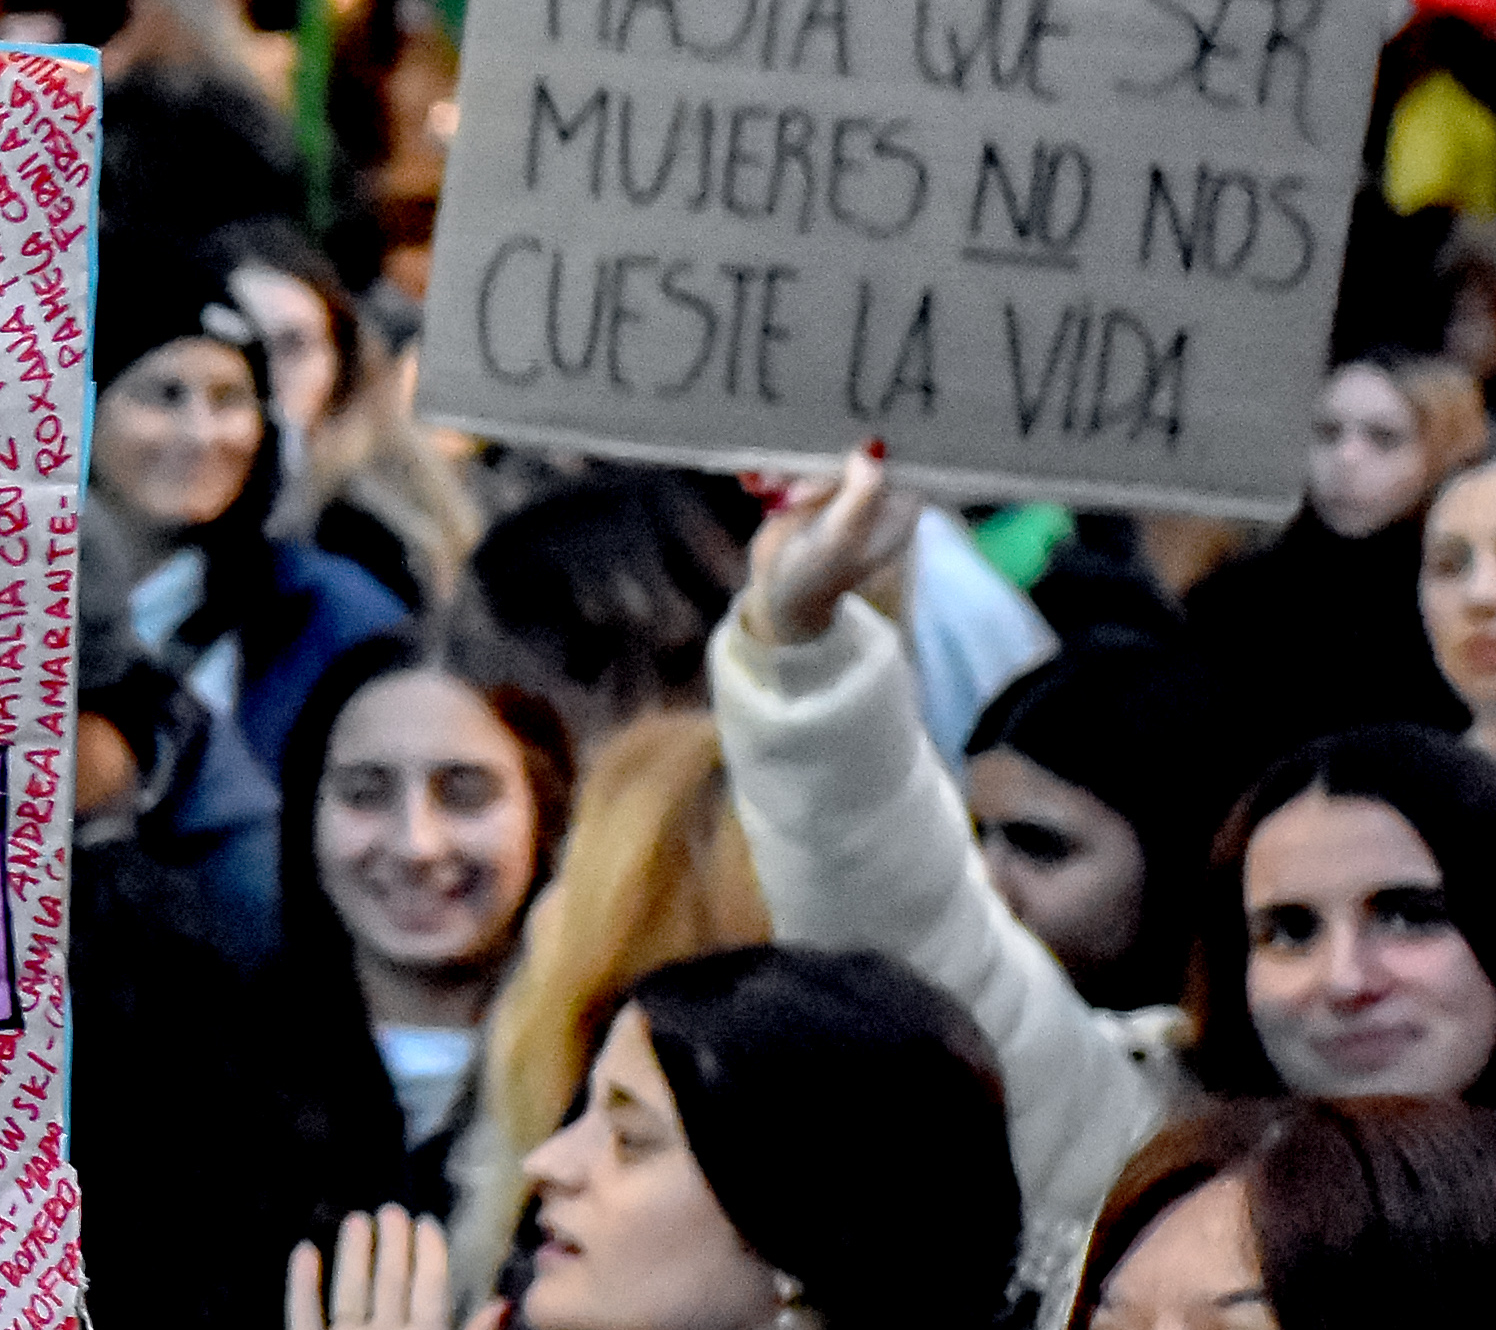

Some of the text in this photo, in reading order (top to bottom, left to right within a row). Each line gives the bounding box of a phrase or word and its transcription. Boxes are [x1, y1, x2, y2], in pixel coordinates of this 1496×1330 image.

[525, 74, 1313, 294] MUJERES NO NOS
[0, 306, 71, 473] ROXANA
[21, 232, 82, 368] PAMELA
[477, 236, 1191, 452] CUESTE LA VIDA
[38, 515, 77, 736] AMARANTE
